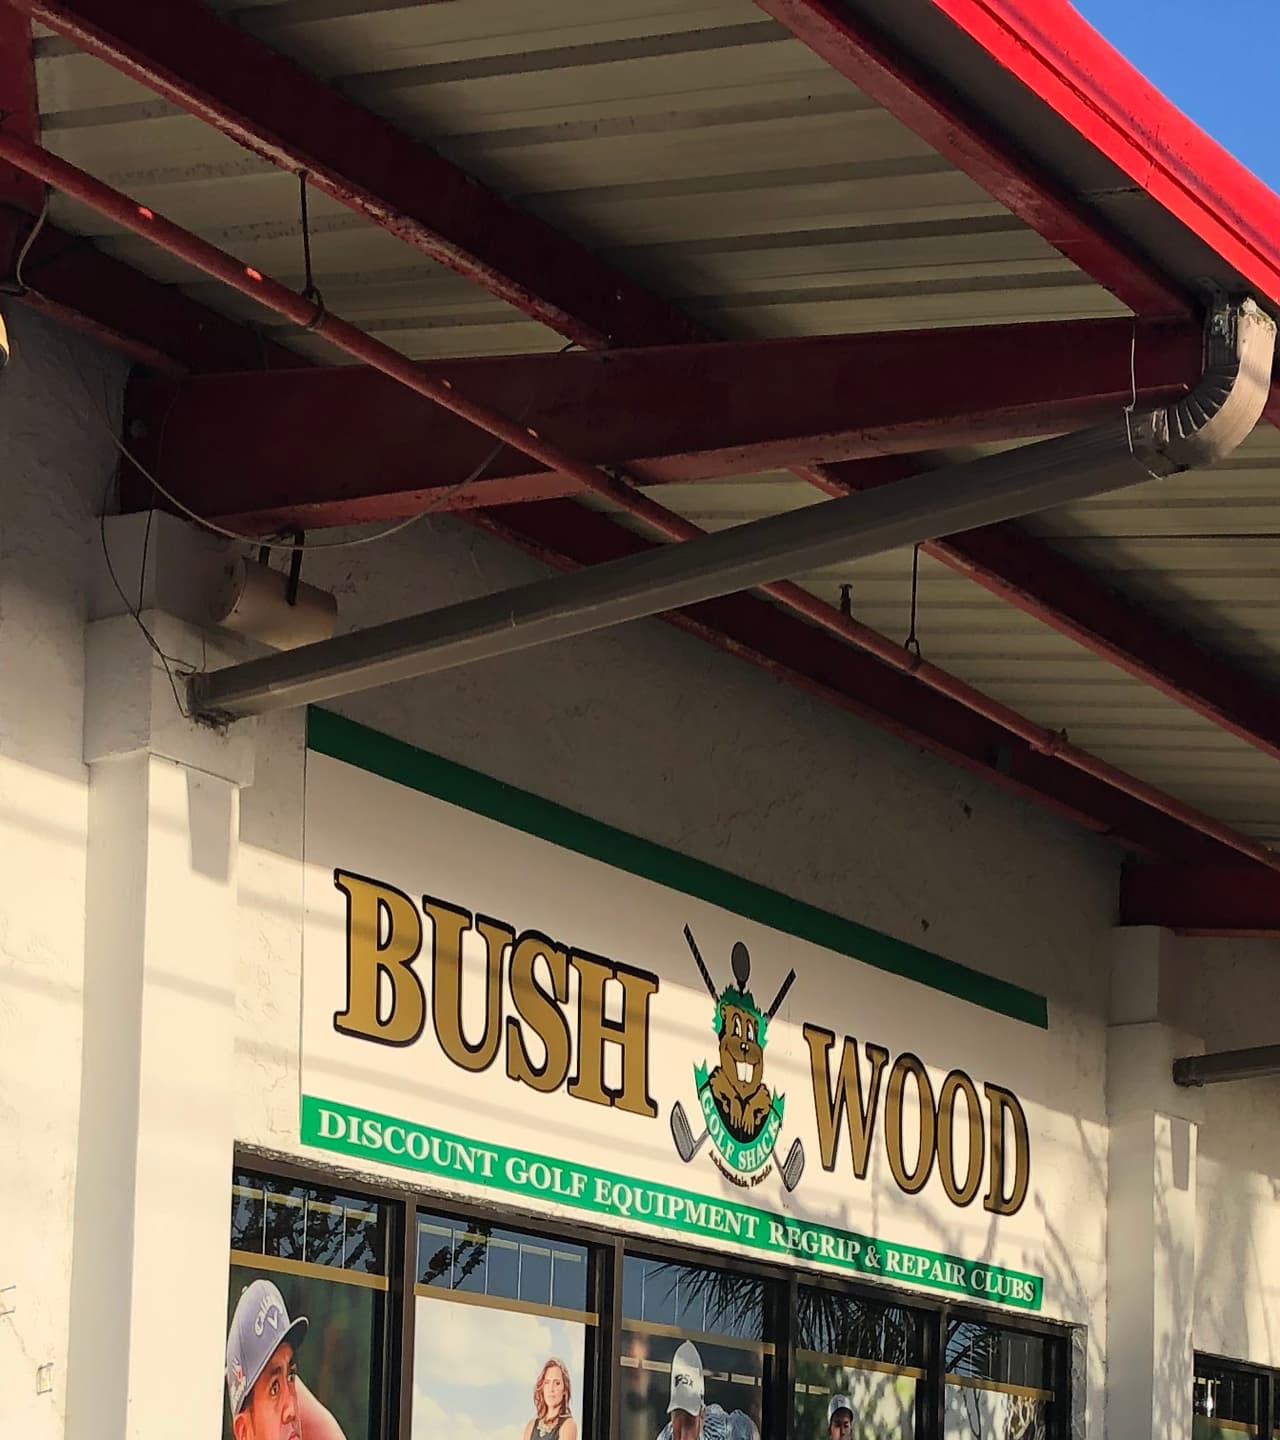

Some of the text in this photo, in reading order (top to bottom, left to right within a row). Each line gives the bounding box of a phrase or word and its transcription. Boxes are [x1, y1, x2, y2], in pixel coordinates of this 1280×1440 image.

[333, 868, 1031, 1217] BUSH WOOD
[700, 1087, 780, 1171] GOLF SHACK
[318, 1109, 1034, 1302] DISCOUNT GOLF EQUIPMENT REGRIP & REPAIR CLUBS
